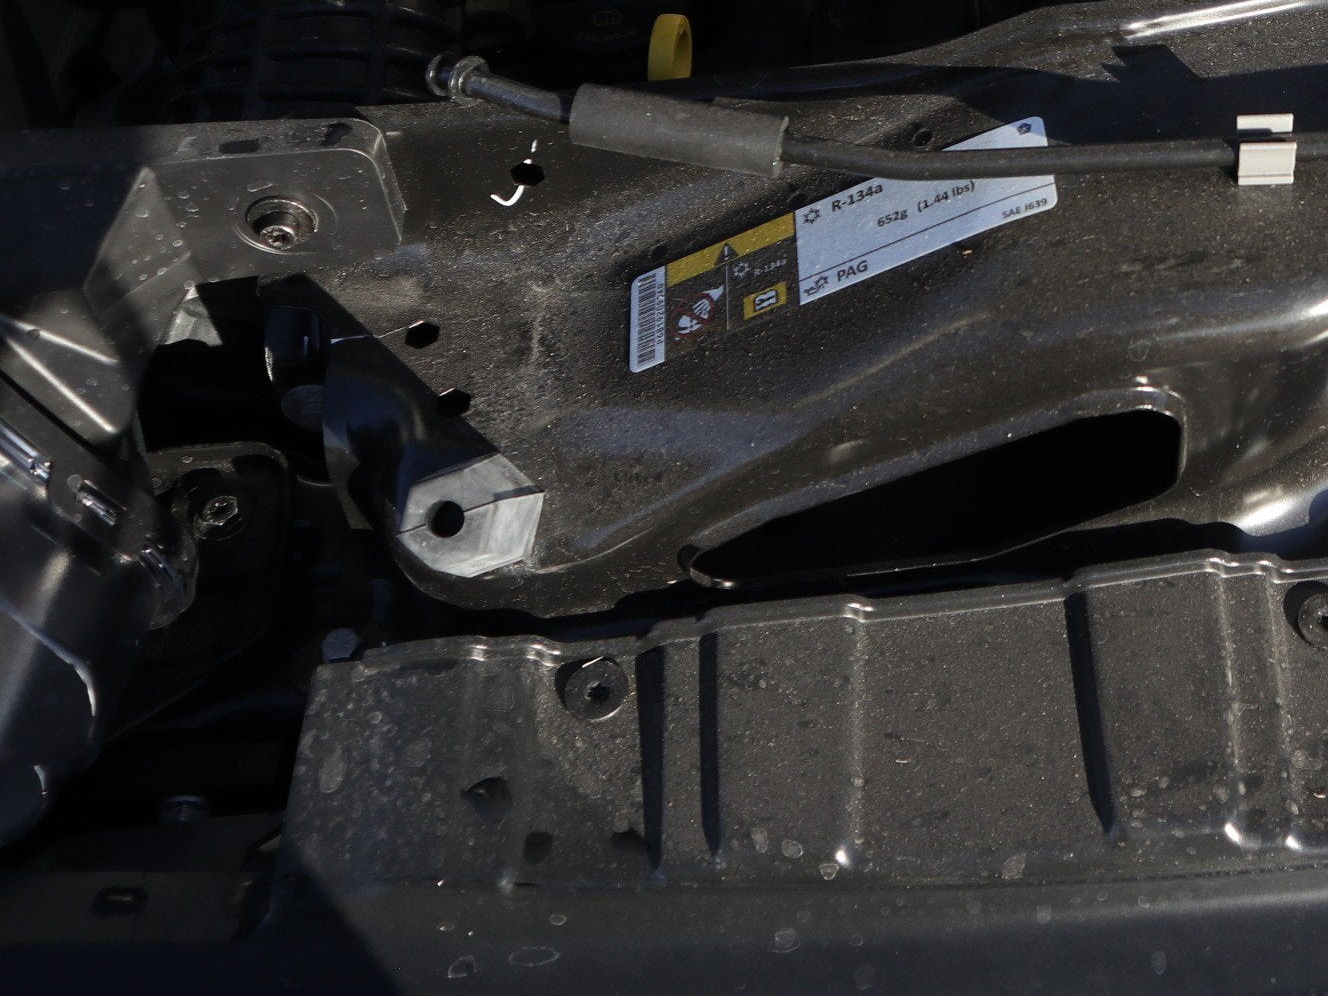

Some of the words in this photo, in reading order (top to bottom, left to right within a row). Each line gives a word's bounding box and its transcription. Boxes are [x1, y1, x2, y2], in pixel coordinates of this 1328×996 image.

[831, 184, 883, 212] R-134a
[876, 210, 909, 228] 652g
[917, 190, 950, 213] (1.44
[951, 179, 976, 200] lbs)
[1002, 205, 1022, 220] SAE
[1024, 197, 1048, 213] J639
[836, 260, 869, 283] PAG
